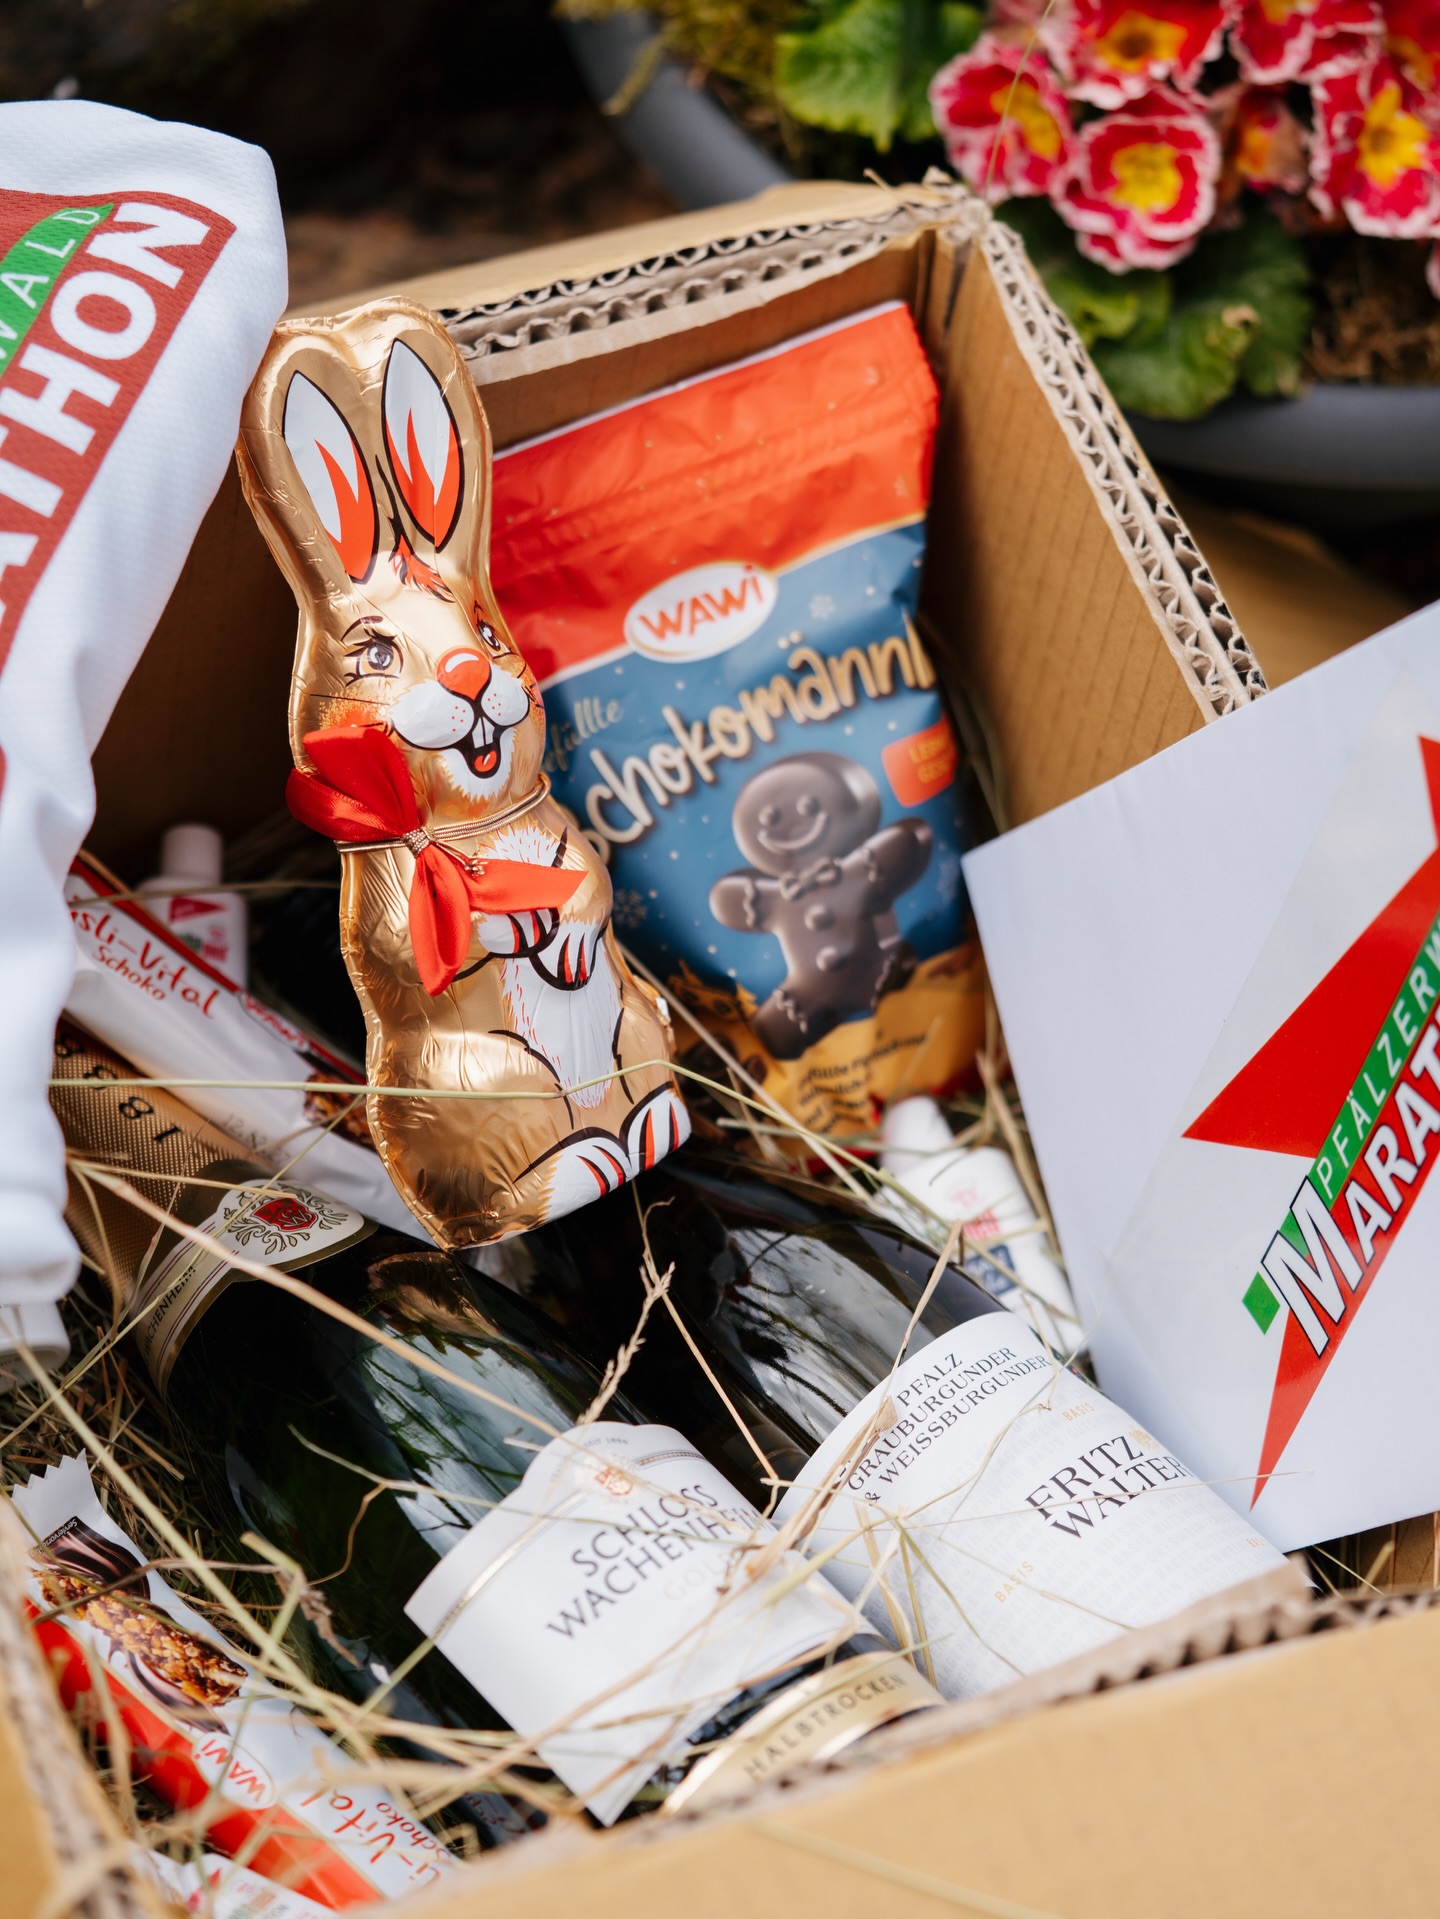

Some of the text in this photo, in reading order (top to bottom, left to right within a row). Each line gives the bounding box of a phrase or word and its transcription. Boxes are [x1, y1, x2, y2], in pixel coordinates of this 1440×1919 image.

[545, 697, 624, 773] efüllte
[70, 896, 219, 1019] sli-Vital
[92, 945, 166, 1001] Schoko
[1261, 1003, 1440, 1359] MARAT
[848, 1347, 1017, 1491] GRAUBURGUNDER
[897, 1353, 963, 1407] PFALZ
[1062, 1402, 1095, 1421] BASIS
[864, 1491, 881, 1505] &
[878, 1355, 1052, 1485] WEISSBURGUNDER
[1025, 1436, 1144, 1521] FRITZ
[1050, 1456, 1194, 1539] WALTER
[572, 1485, 718, 1577] SCHLOSS
[994, 1560, 1035, 1604] BASIS
[744, 1672, 908, 1782] HALBTROCKEN
